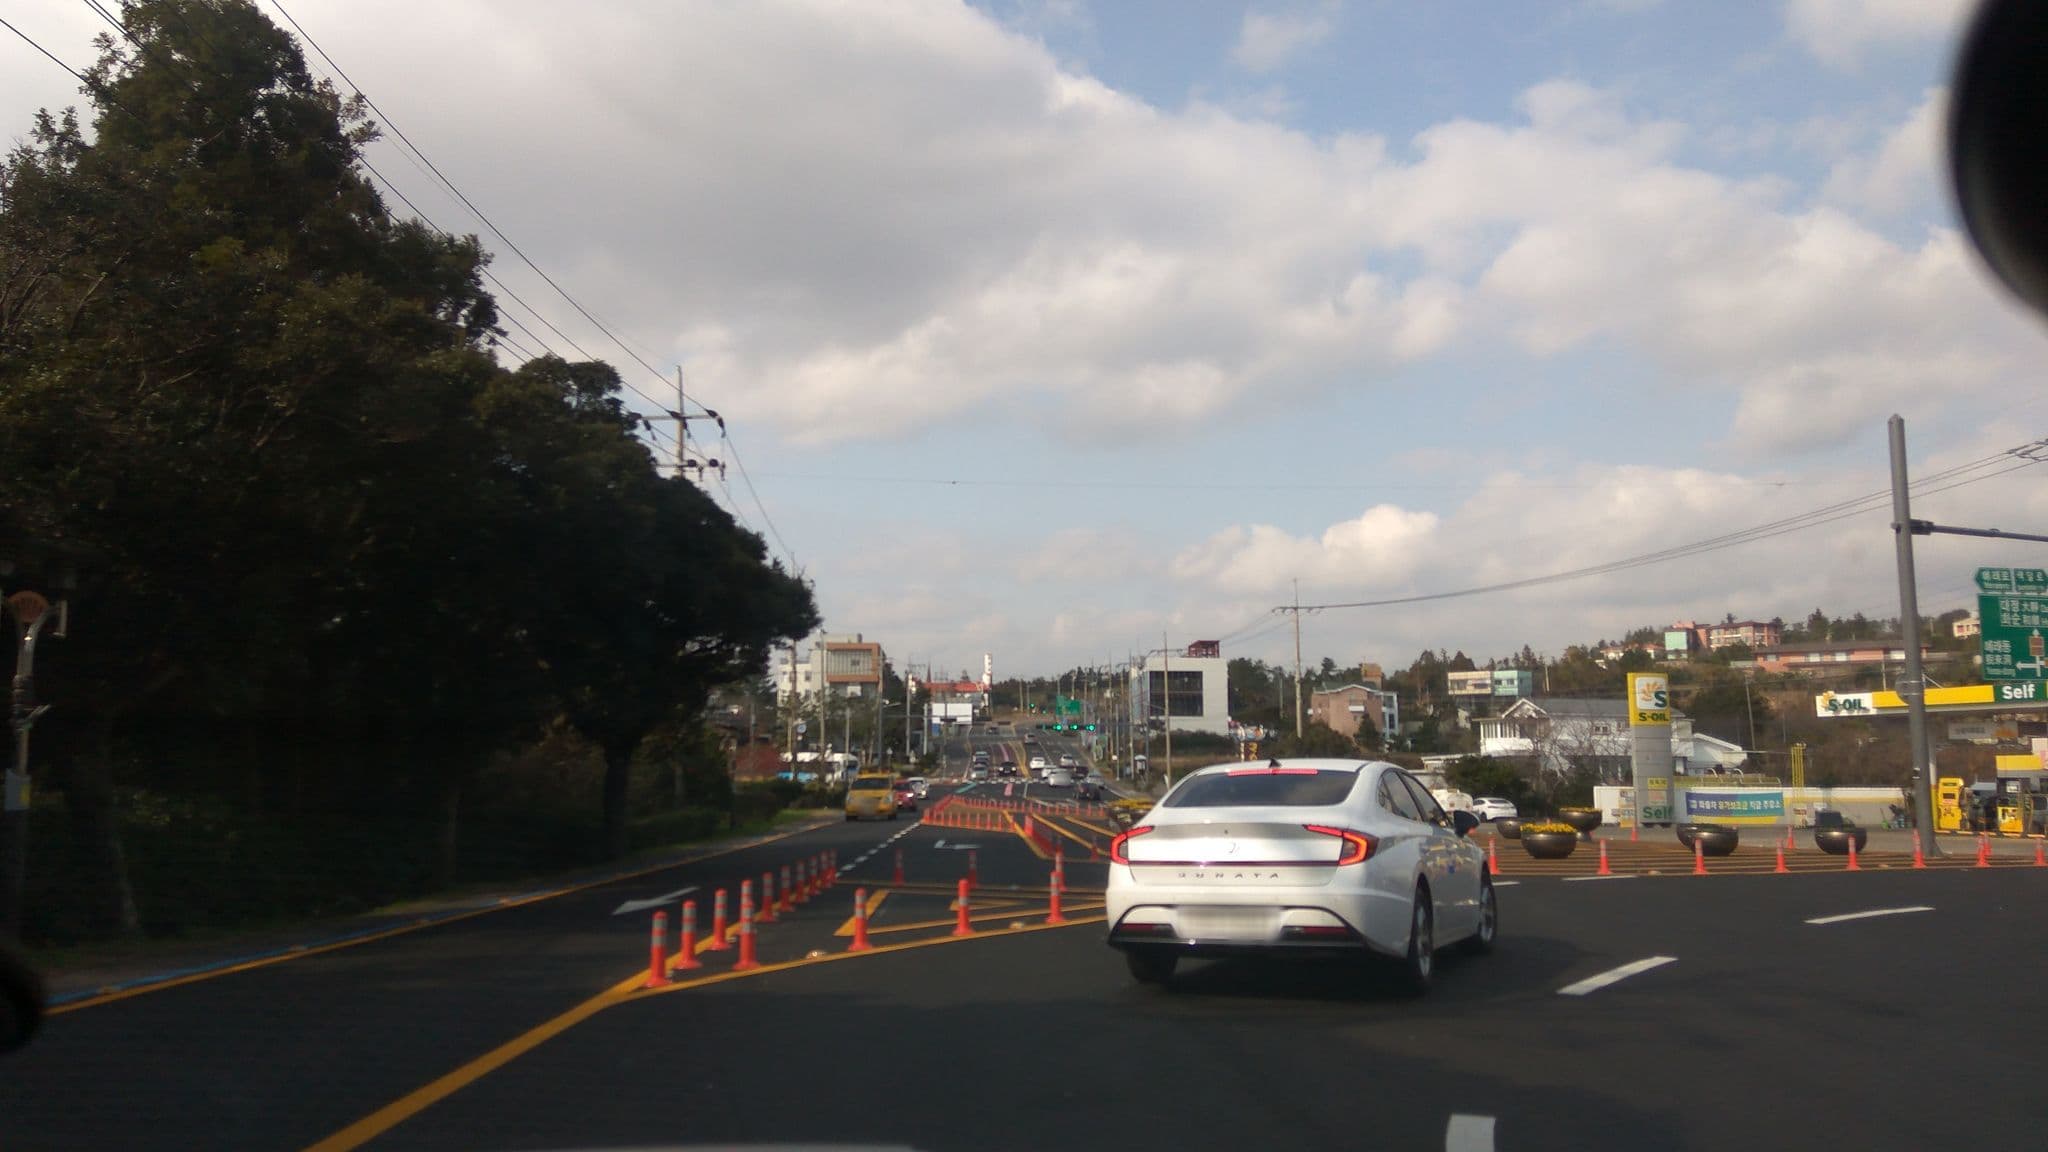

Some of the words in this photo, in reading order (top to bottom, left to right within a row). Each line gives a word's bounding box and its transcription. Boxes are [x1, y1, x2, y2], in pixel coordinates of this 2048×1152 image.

[1654, 690, 1668, 708] S
[2002, 684, 2036, 700] Self
[1828, 698, 1866, 712] S-OIL
[1638, 712, 1669, 722] S-OIL
[1643, 806, 1674, 819] Self
